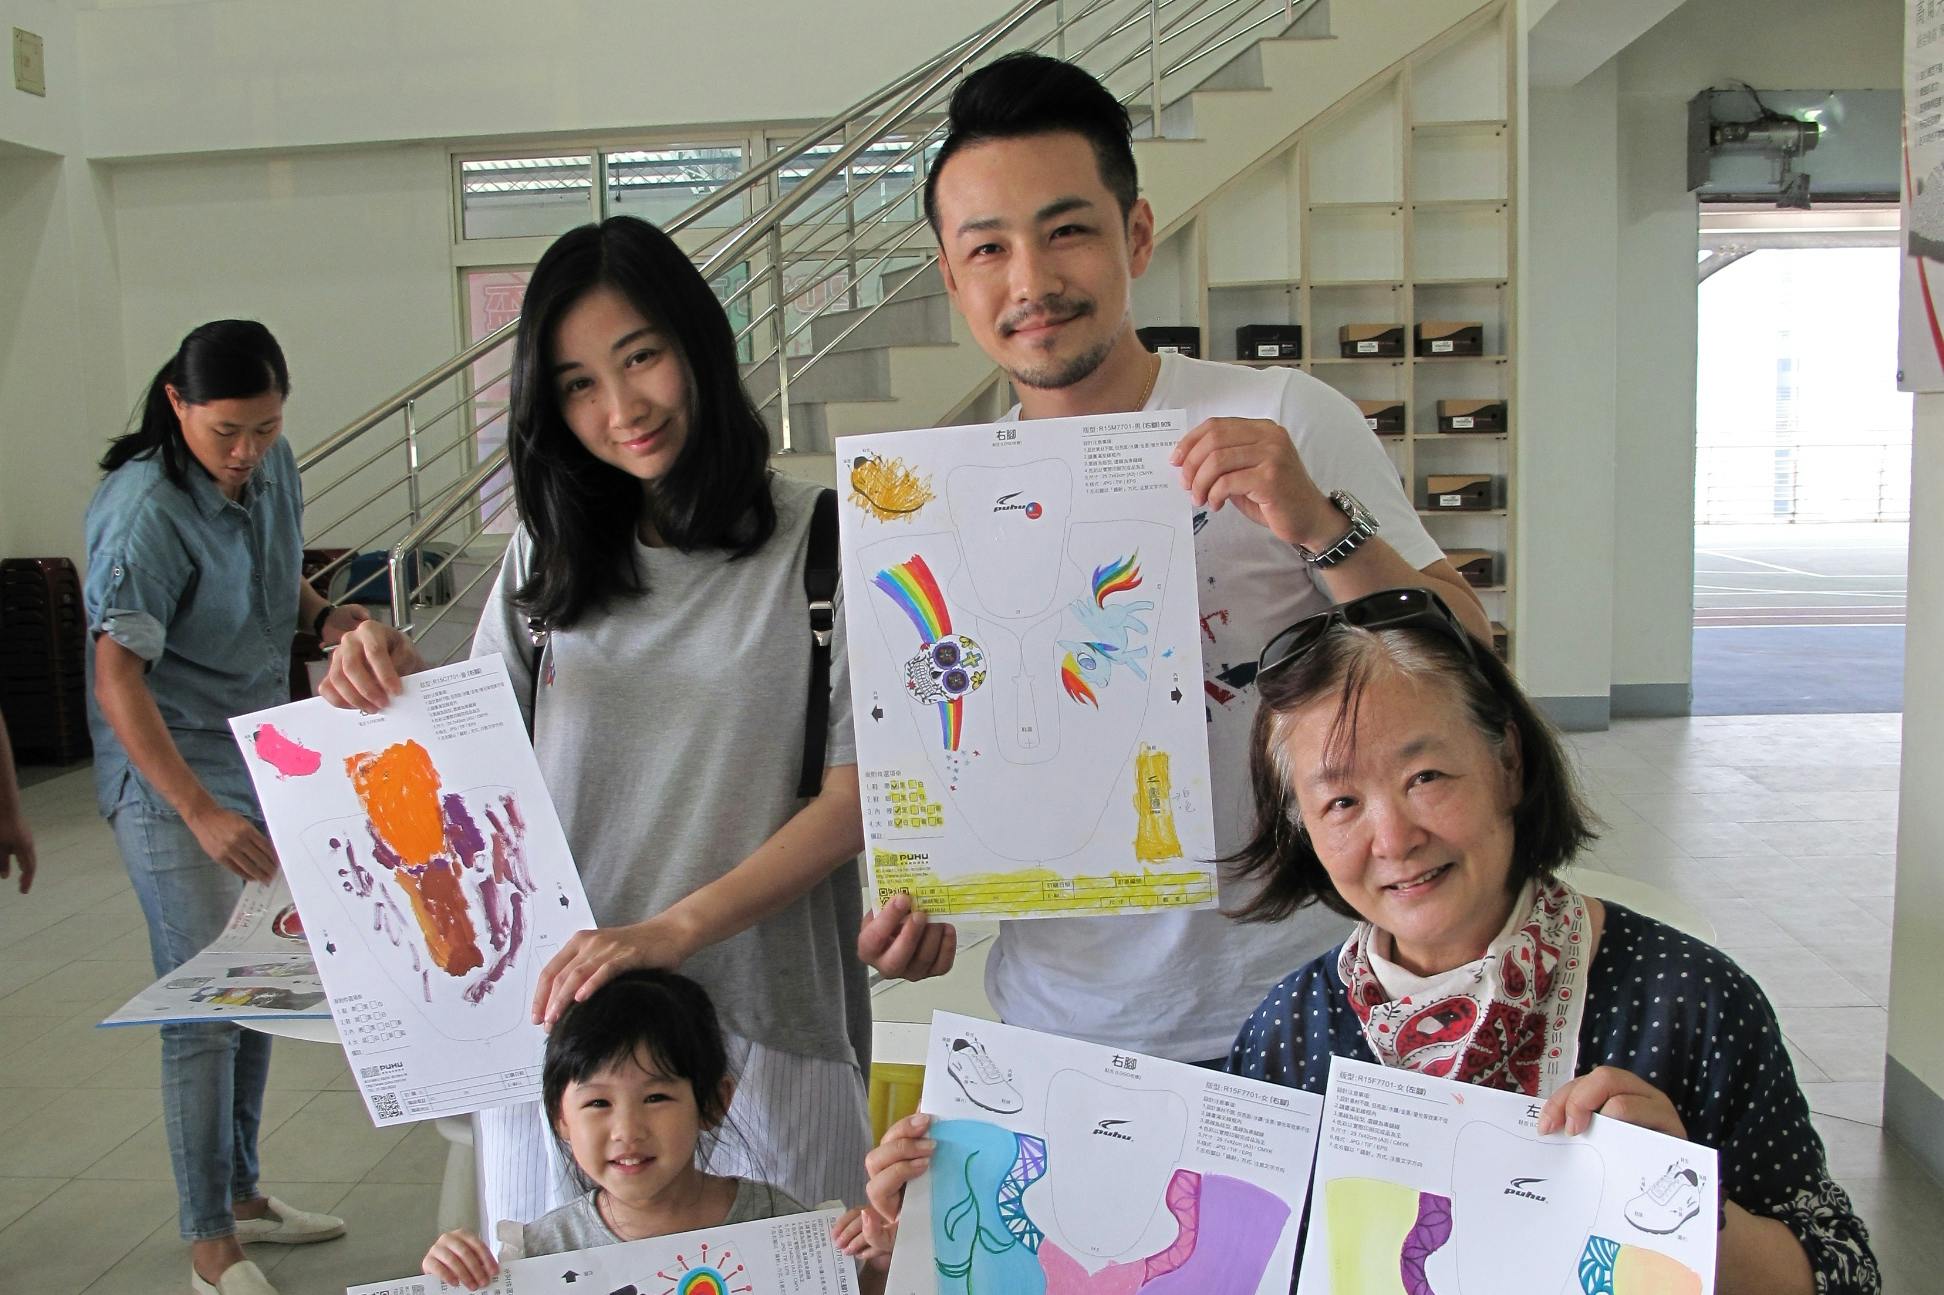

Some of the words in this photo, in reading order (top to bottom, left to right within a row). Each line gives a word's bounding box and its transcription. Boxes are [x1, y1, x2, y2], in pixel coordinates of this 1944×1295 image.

[996, 429, 1016, 441] 右腳
[899, 853, 929, 861] PUHU
[1112, 1054, 1137, 1070] 右腳
[1093, 1129, 1132, 1141] puhu
[1504, 1188, 1547, 1202] puhu
